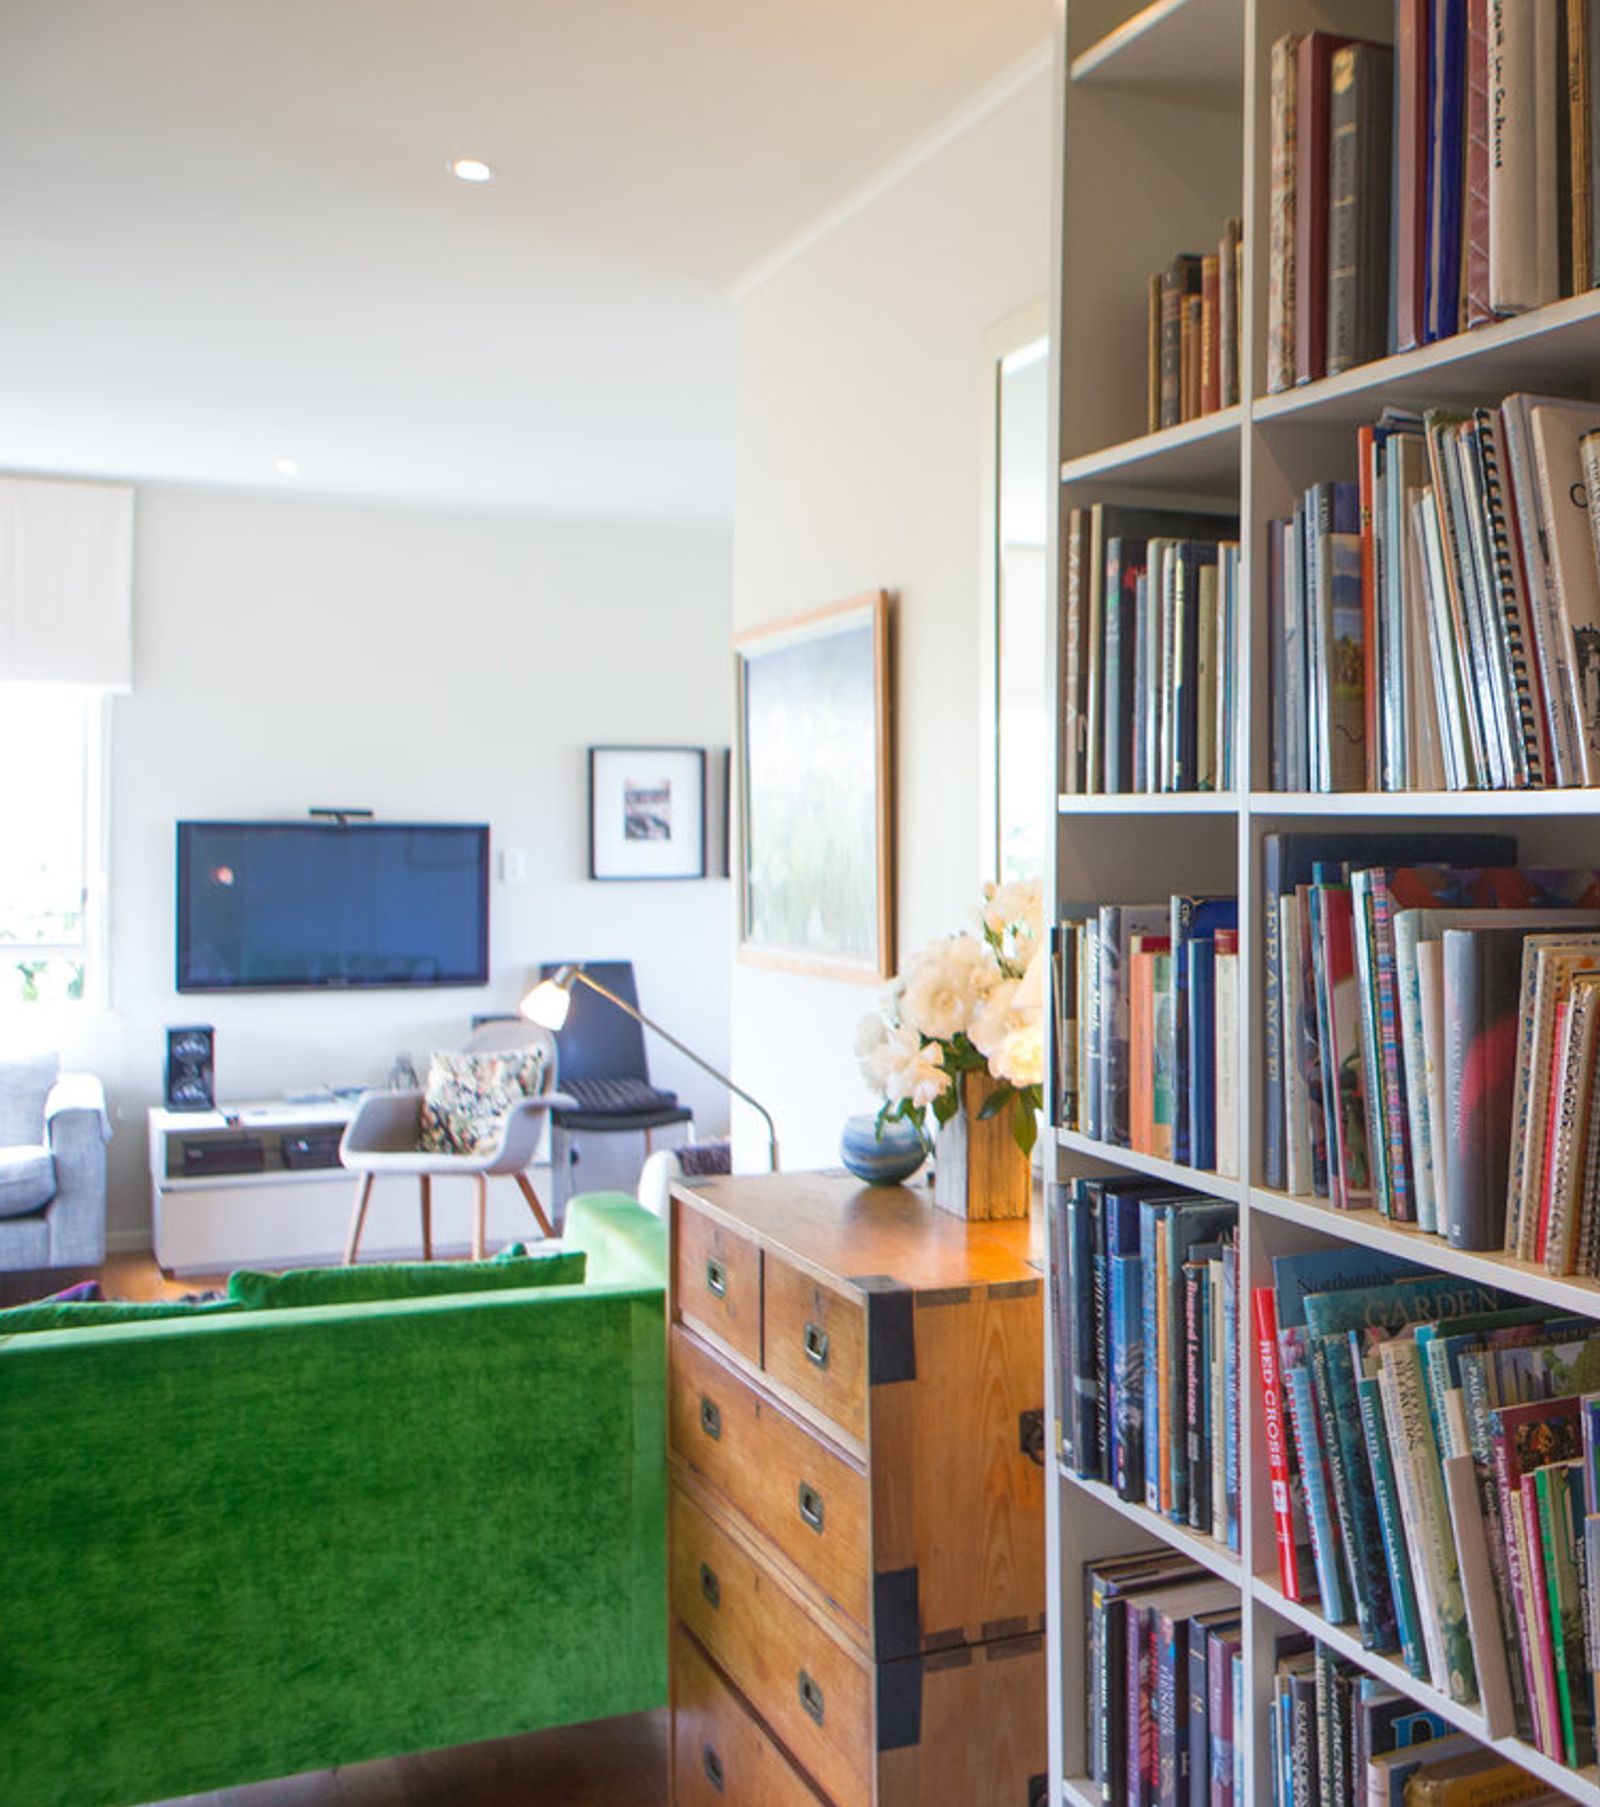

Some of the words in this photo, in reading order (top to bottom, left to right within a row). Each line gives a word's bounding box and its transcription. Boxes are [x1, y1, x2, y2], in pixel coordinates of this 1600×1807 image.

[1065, 533, 1080, 726] MANDELA
[1093, 1269, 1105, 1323] WILD
[1186, 1280, 1199, 1340] Rugged
[1365, 1288, 1500, 1328] GARDEN
[1095, 1325, 1106, 1364] NEW
[1259, 1339, 1274, 1385] RED
[1095, 1365, 1108, 1453] ZEALAND
[1186, 1343, 1199, 1424] Landscape
[1465, 1364, 1482, 1404] PAUL
[1264, 1389, 1282, 1467] CROSS
[1329, 1455, 1347, 1503] Making
[1493, 1444, 1509, 1482] Plant
[1497, 1485, 1517, 1543] Pruning
[1509, 1561, 1521, 1578] to
[1316, 1657, 1327, 1712] NATURAL
[1333, 1721, 1345, 1780] FACTS
